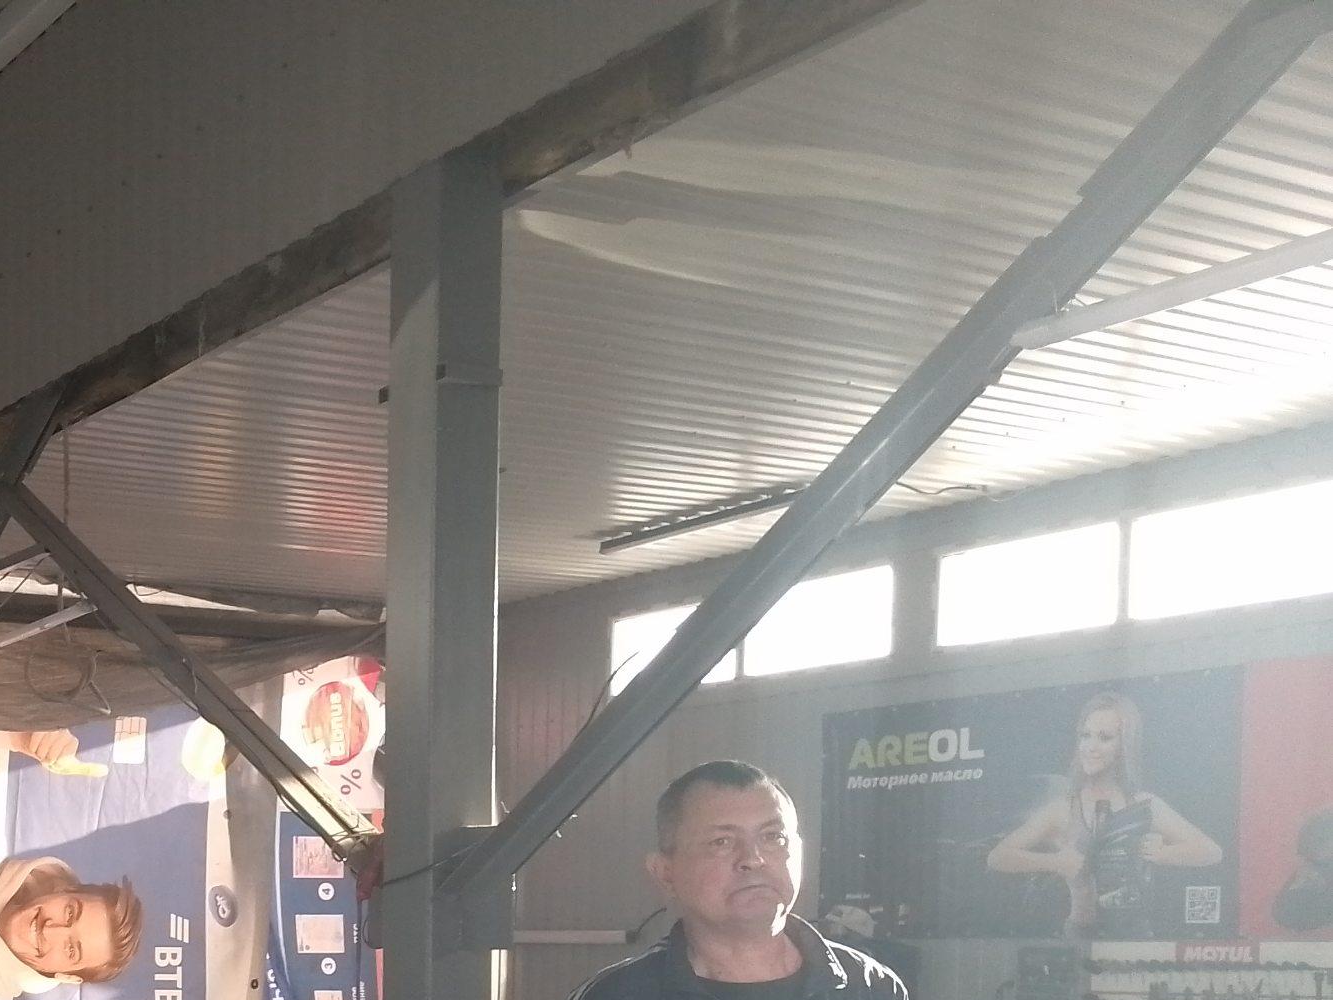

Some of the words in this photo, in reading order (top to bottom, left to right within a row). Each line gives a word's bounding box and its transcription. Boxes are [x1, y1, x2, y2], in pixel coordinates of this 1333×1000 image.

[848, 727, 985, 770] AREOL
[847, 771, 929, 790] Моторное
[931, 767, 984, 784] масло
[1183, 946, 1254, 962] MOTUL
